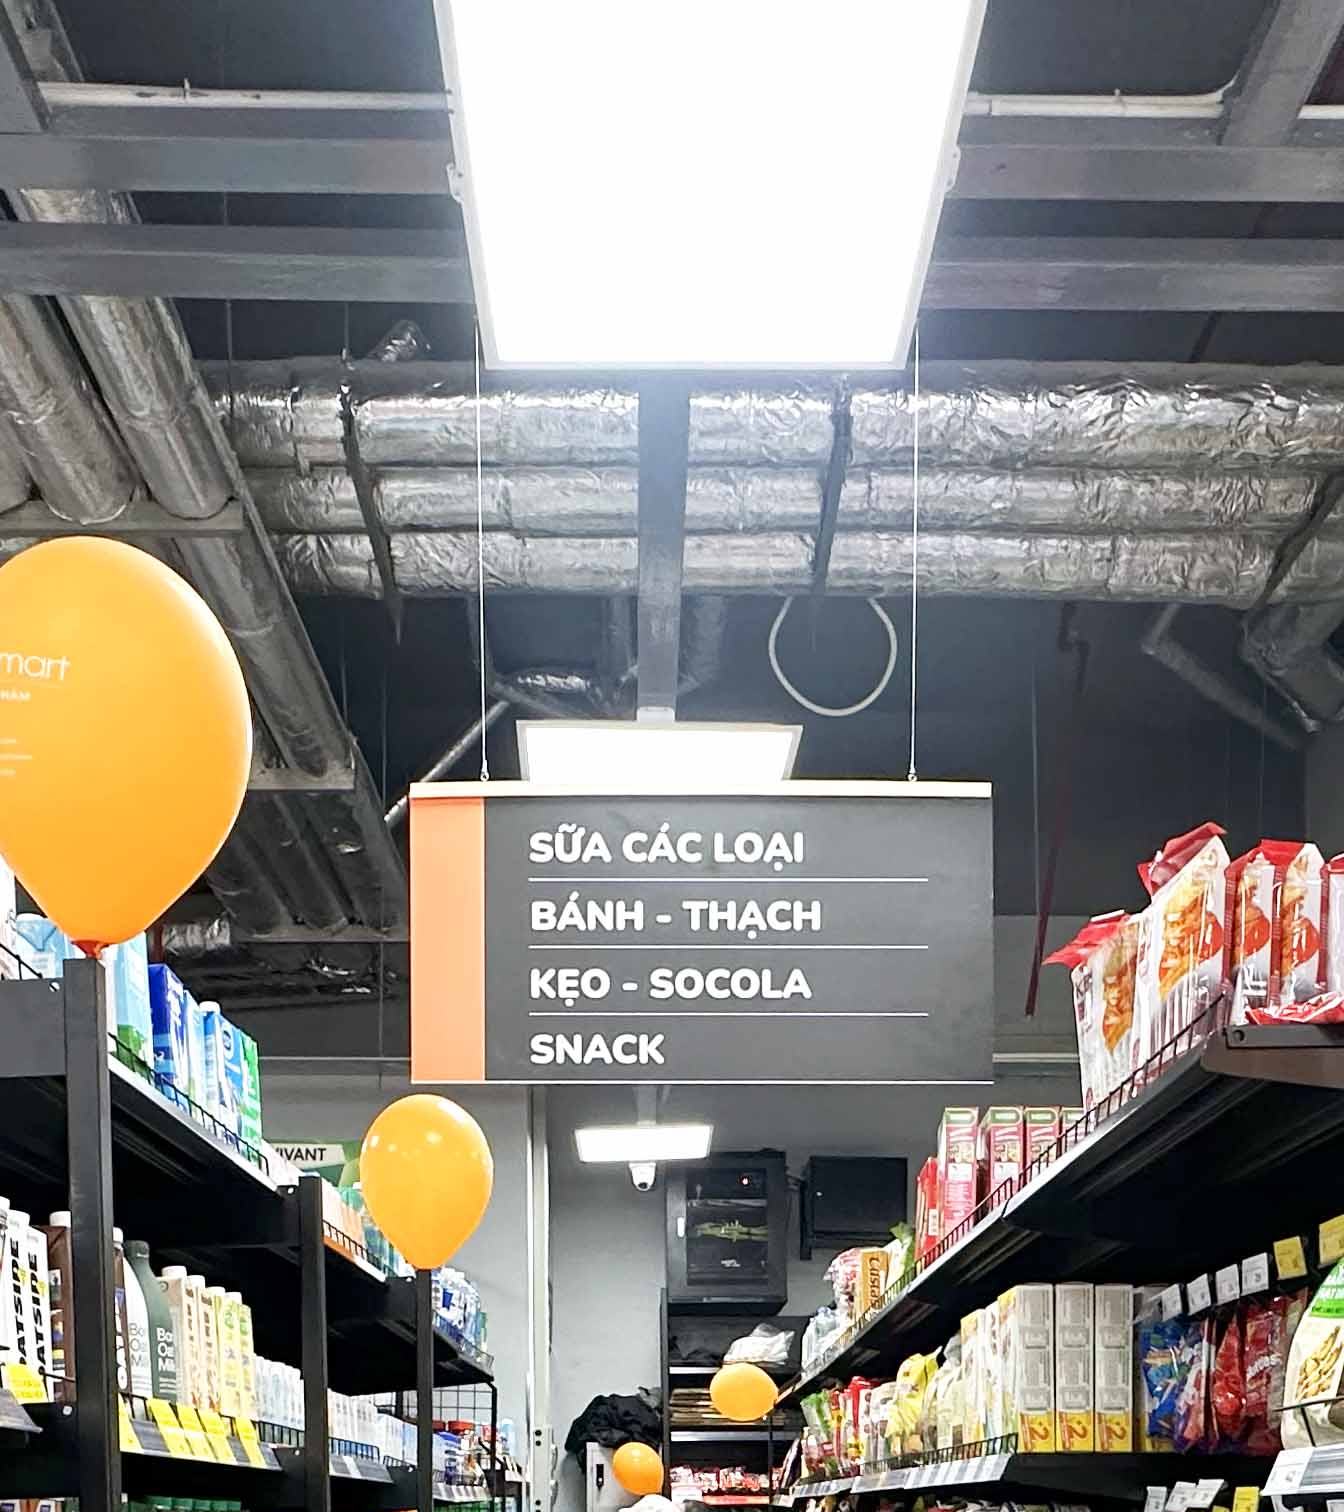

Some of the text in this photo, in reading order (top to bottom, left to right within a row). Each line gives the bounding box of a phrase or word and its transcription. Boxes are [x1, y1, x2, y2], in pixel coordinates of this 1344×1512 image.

[529, 822, 805, 872] SỮA CÁC LOẠI
[531, 891, 645, 932] BÁNH
[682, 900, 823, 940] THẠCH
[531, 968, 611, 1007] KẸO
[649, 968, 814, 1001] SOCOLA
[529, 1033, 666, 1066] SNACK
[277, 1147, 327, 1161] IVANT
